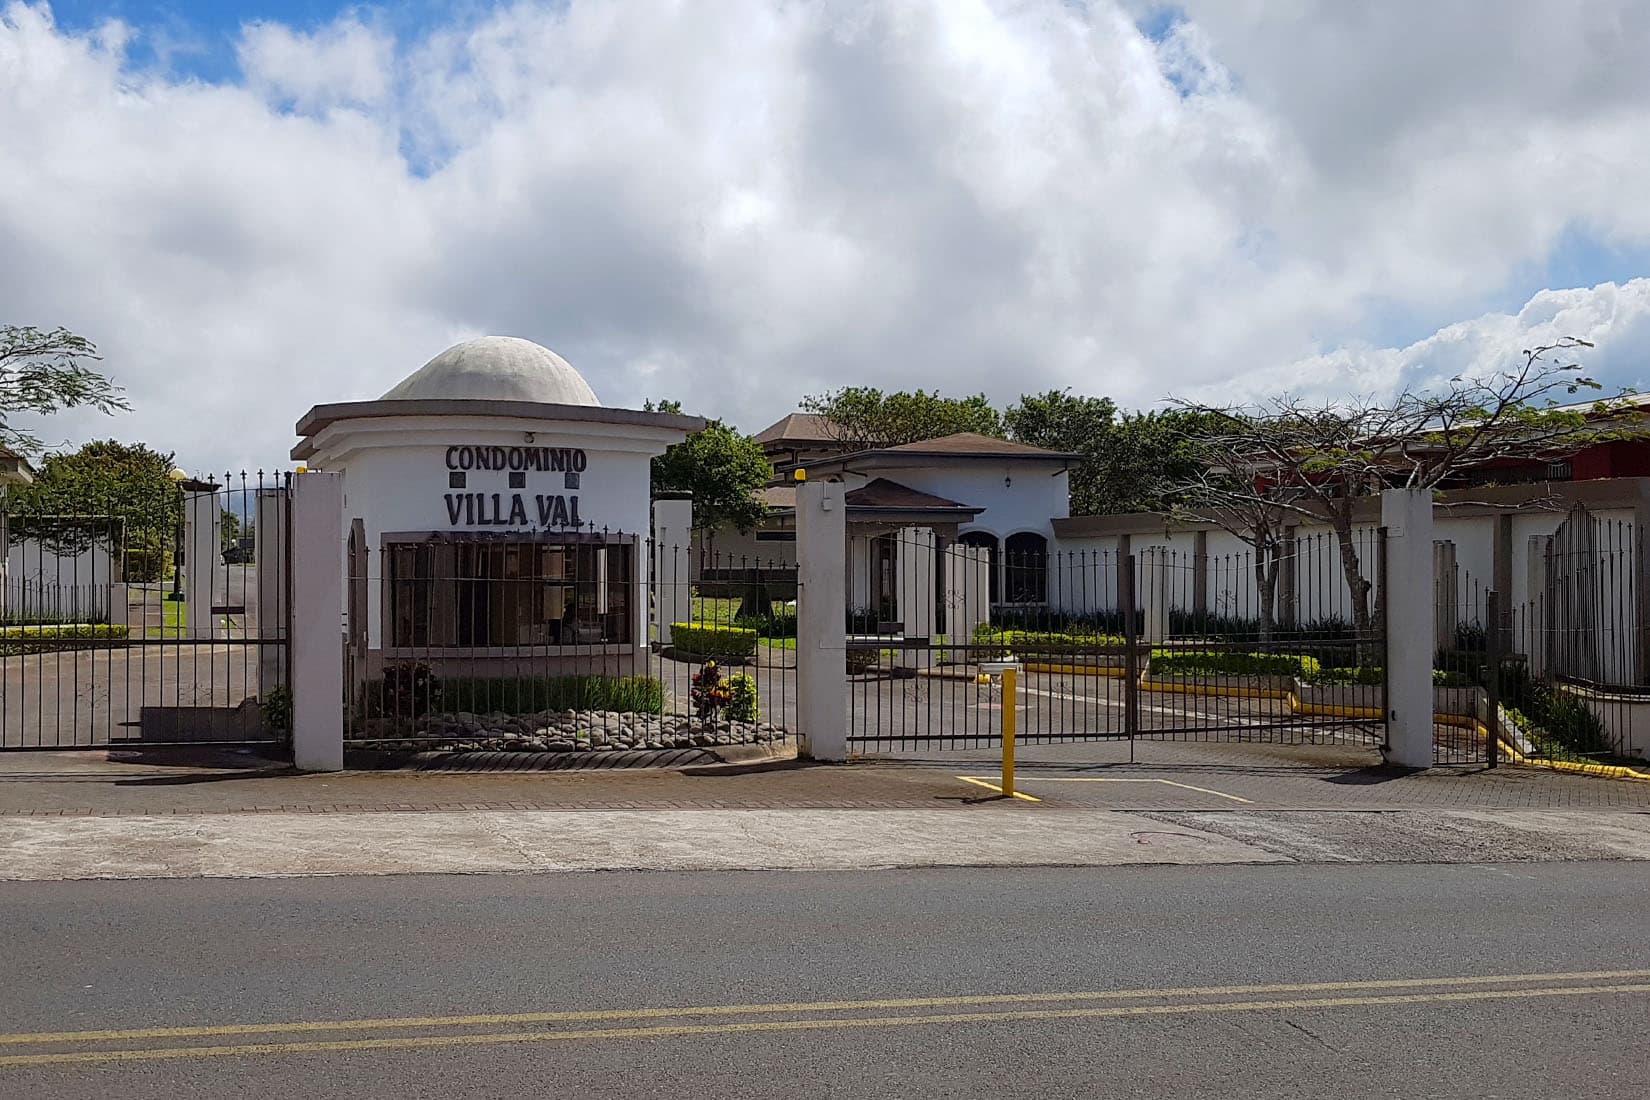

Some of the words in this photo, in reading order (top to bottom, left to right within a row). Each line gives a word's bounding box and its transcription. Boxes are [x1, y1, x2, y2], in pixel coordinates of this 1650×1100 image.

[445, 446, 587, 472] CONDOMINIO
[444, 493, 528, 525] VILLA
[536, 495, 584, 527] VAL
